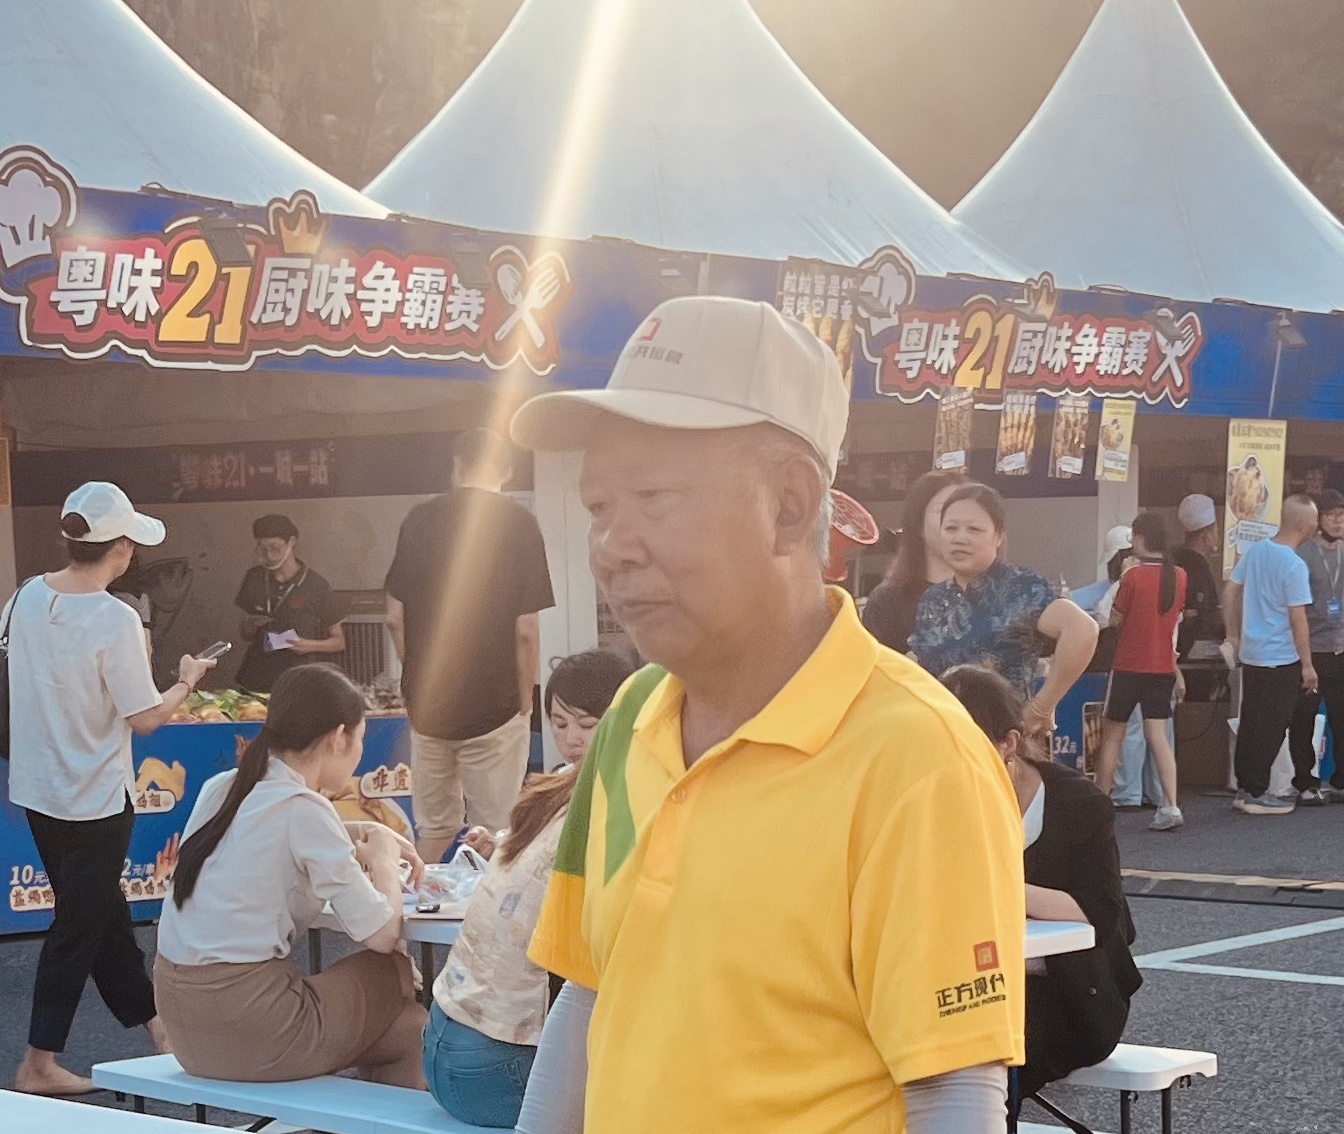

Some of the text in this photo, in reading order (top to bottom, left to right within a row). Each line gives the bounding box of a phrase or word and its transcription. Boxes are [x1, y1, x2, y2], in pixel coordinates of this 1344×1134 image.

[49, 238, 485, 345] 粤味21厨味争霸赛
[894, 310, 1152, 390] 粤味21厨味争霸赛
